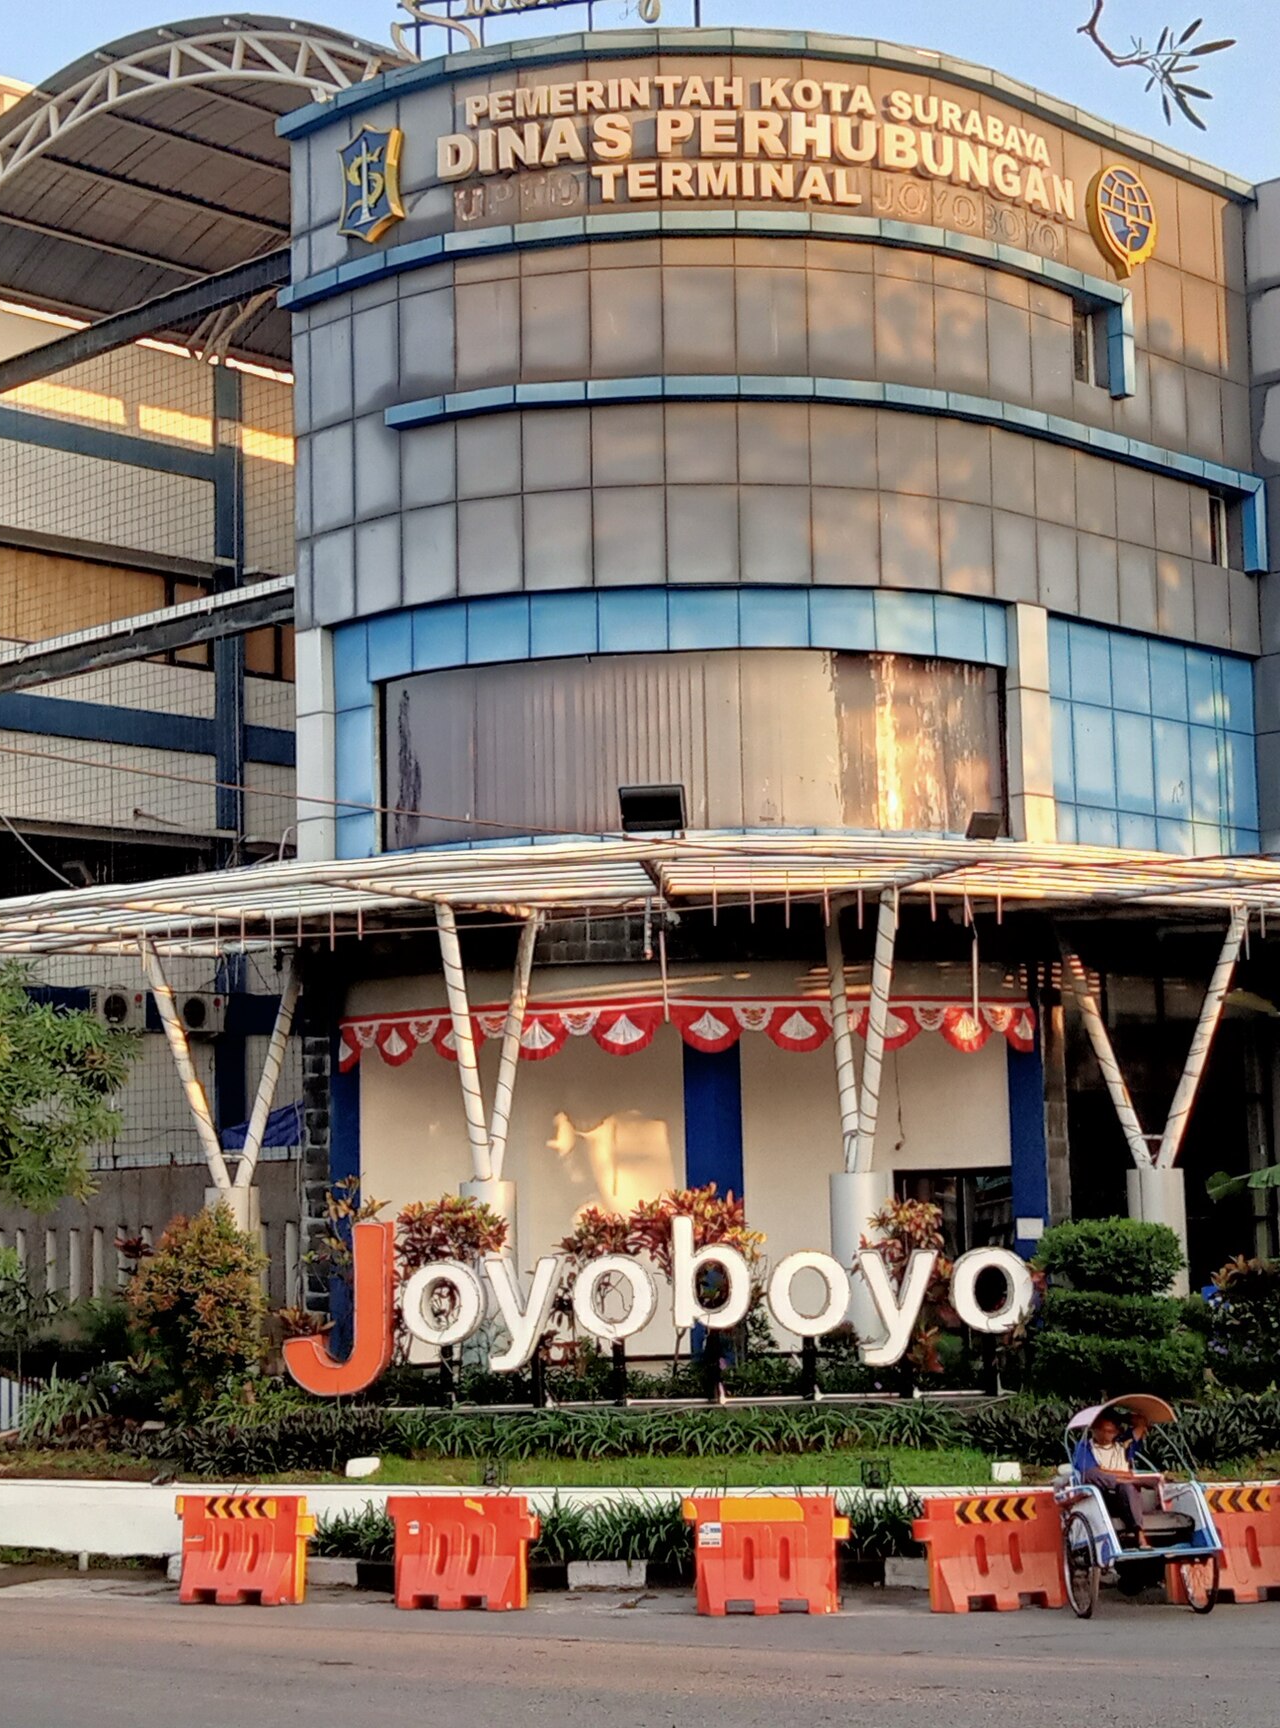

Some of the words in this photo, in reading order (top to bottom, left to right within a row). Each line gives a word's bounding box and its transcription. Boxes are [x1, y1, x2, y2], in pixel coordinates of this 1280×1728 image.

[436, 113, 633, 181] DINAS
[656, 110, 1076, 221] PERHUBUNGAN
[465, 76, 743, 129] PEMERINTAH
[759, 77, 877, 116] KOTA
[888, 89, 1051, 168] SURABAYA
[591, 162, 862, 204] TERMINAL
[283, 1216, 1035, 1397] Joyoboyo
